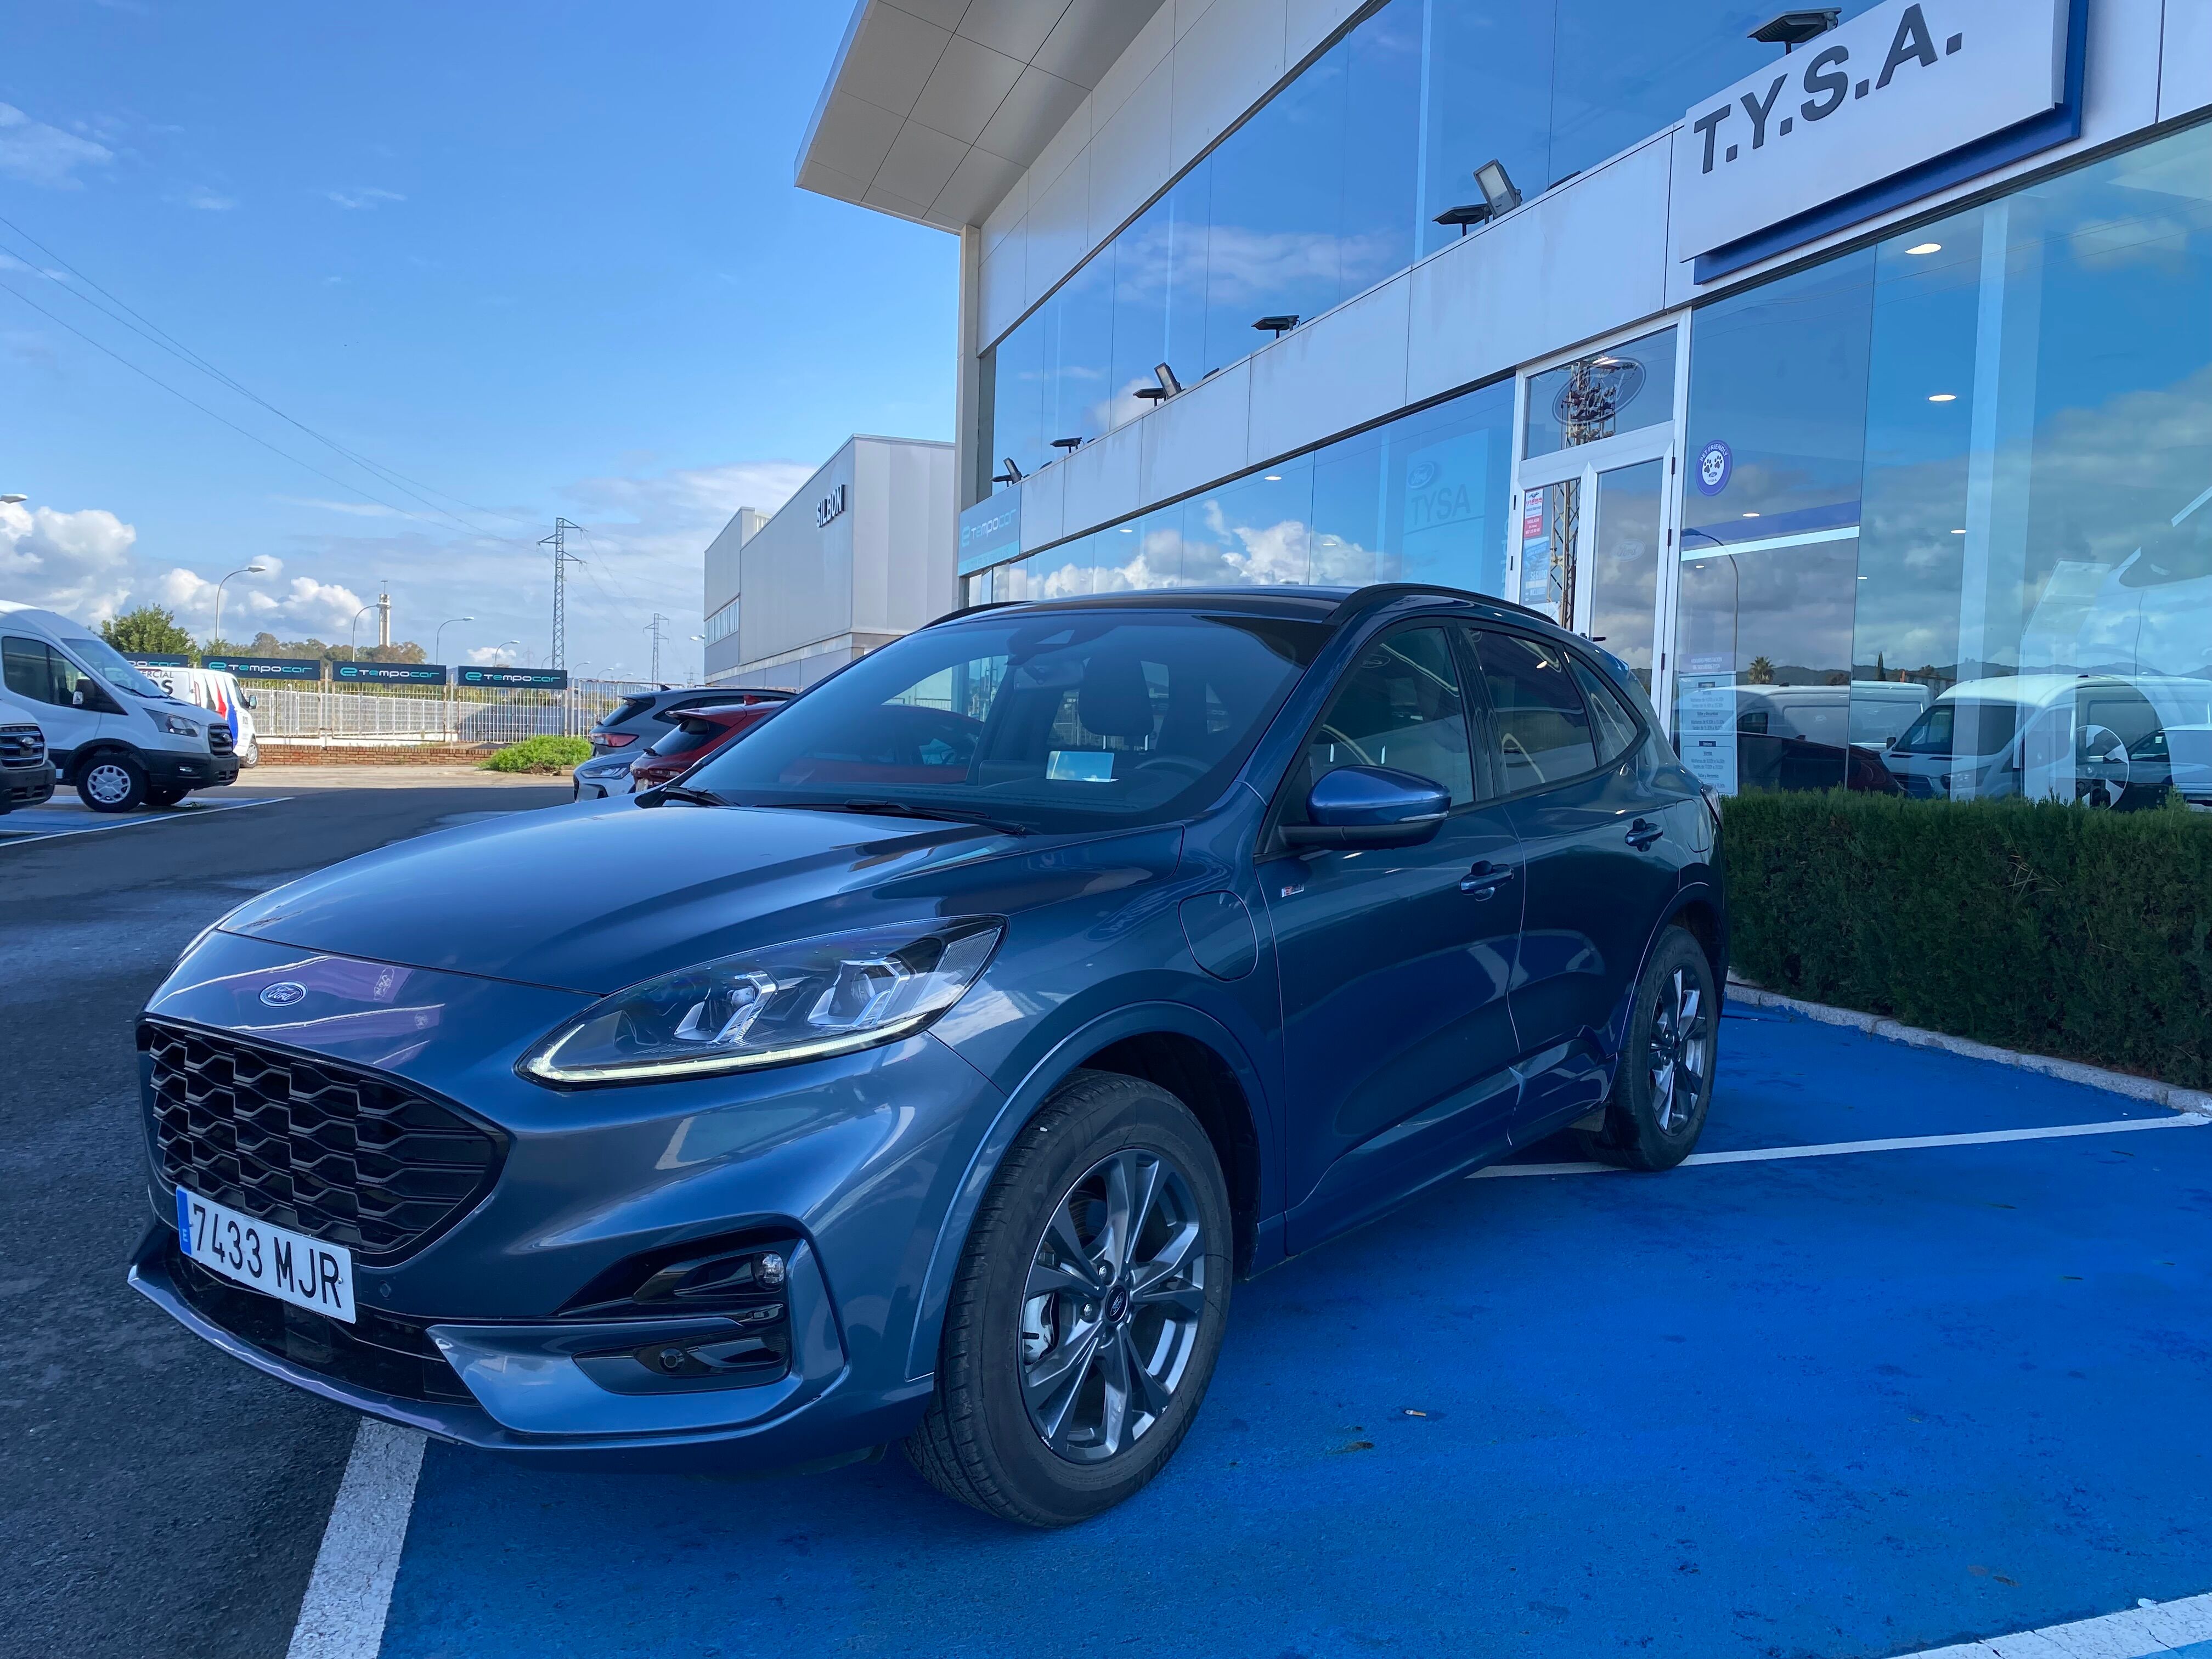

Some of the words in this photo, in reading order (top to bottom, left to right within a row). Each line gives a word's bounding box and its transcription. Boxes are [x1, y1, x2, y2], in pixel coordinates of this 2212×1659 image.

[1694, 3, 1962, 174] T.Y.S.A.
[1708, 443, 1728, 456] FRIENDLY
[816, 484, 845, 528] SILBON
[1410, 483, 1471, 526] TYSA
[268, 986, 297, 1001] Ford
[182, 1228, 188, 1243] E
[193, 1203, 262, 1278] 7433
[273, 1236, 341, 1308] MJR
